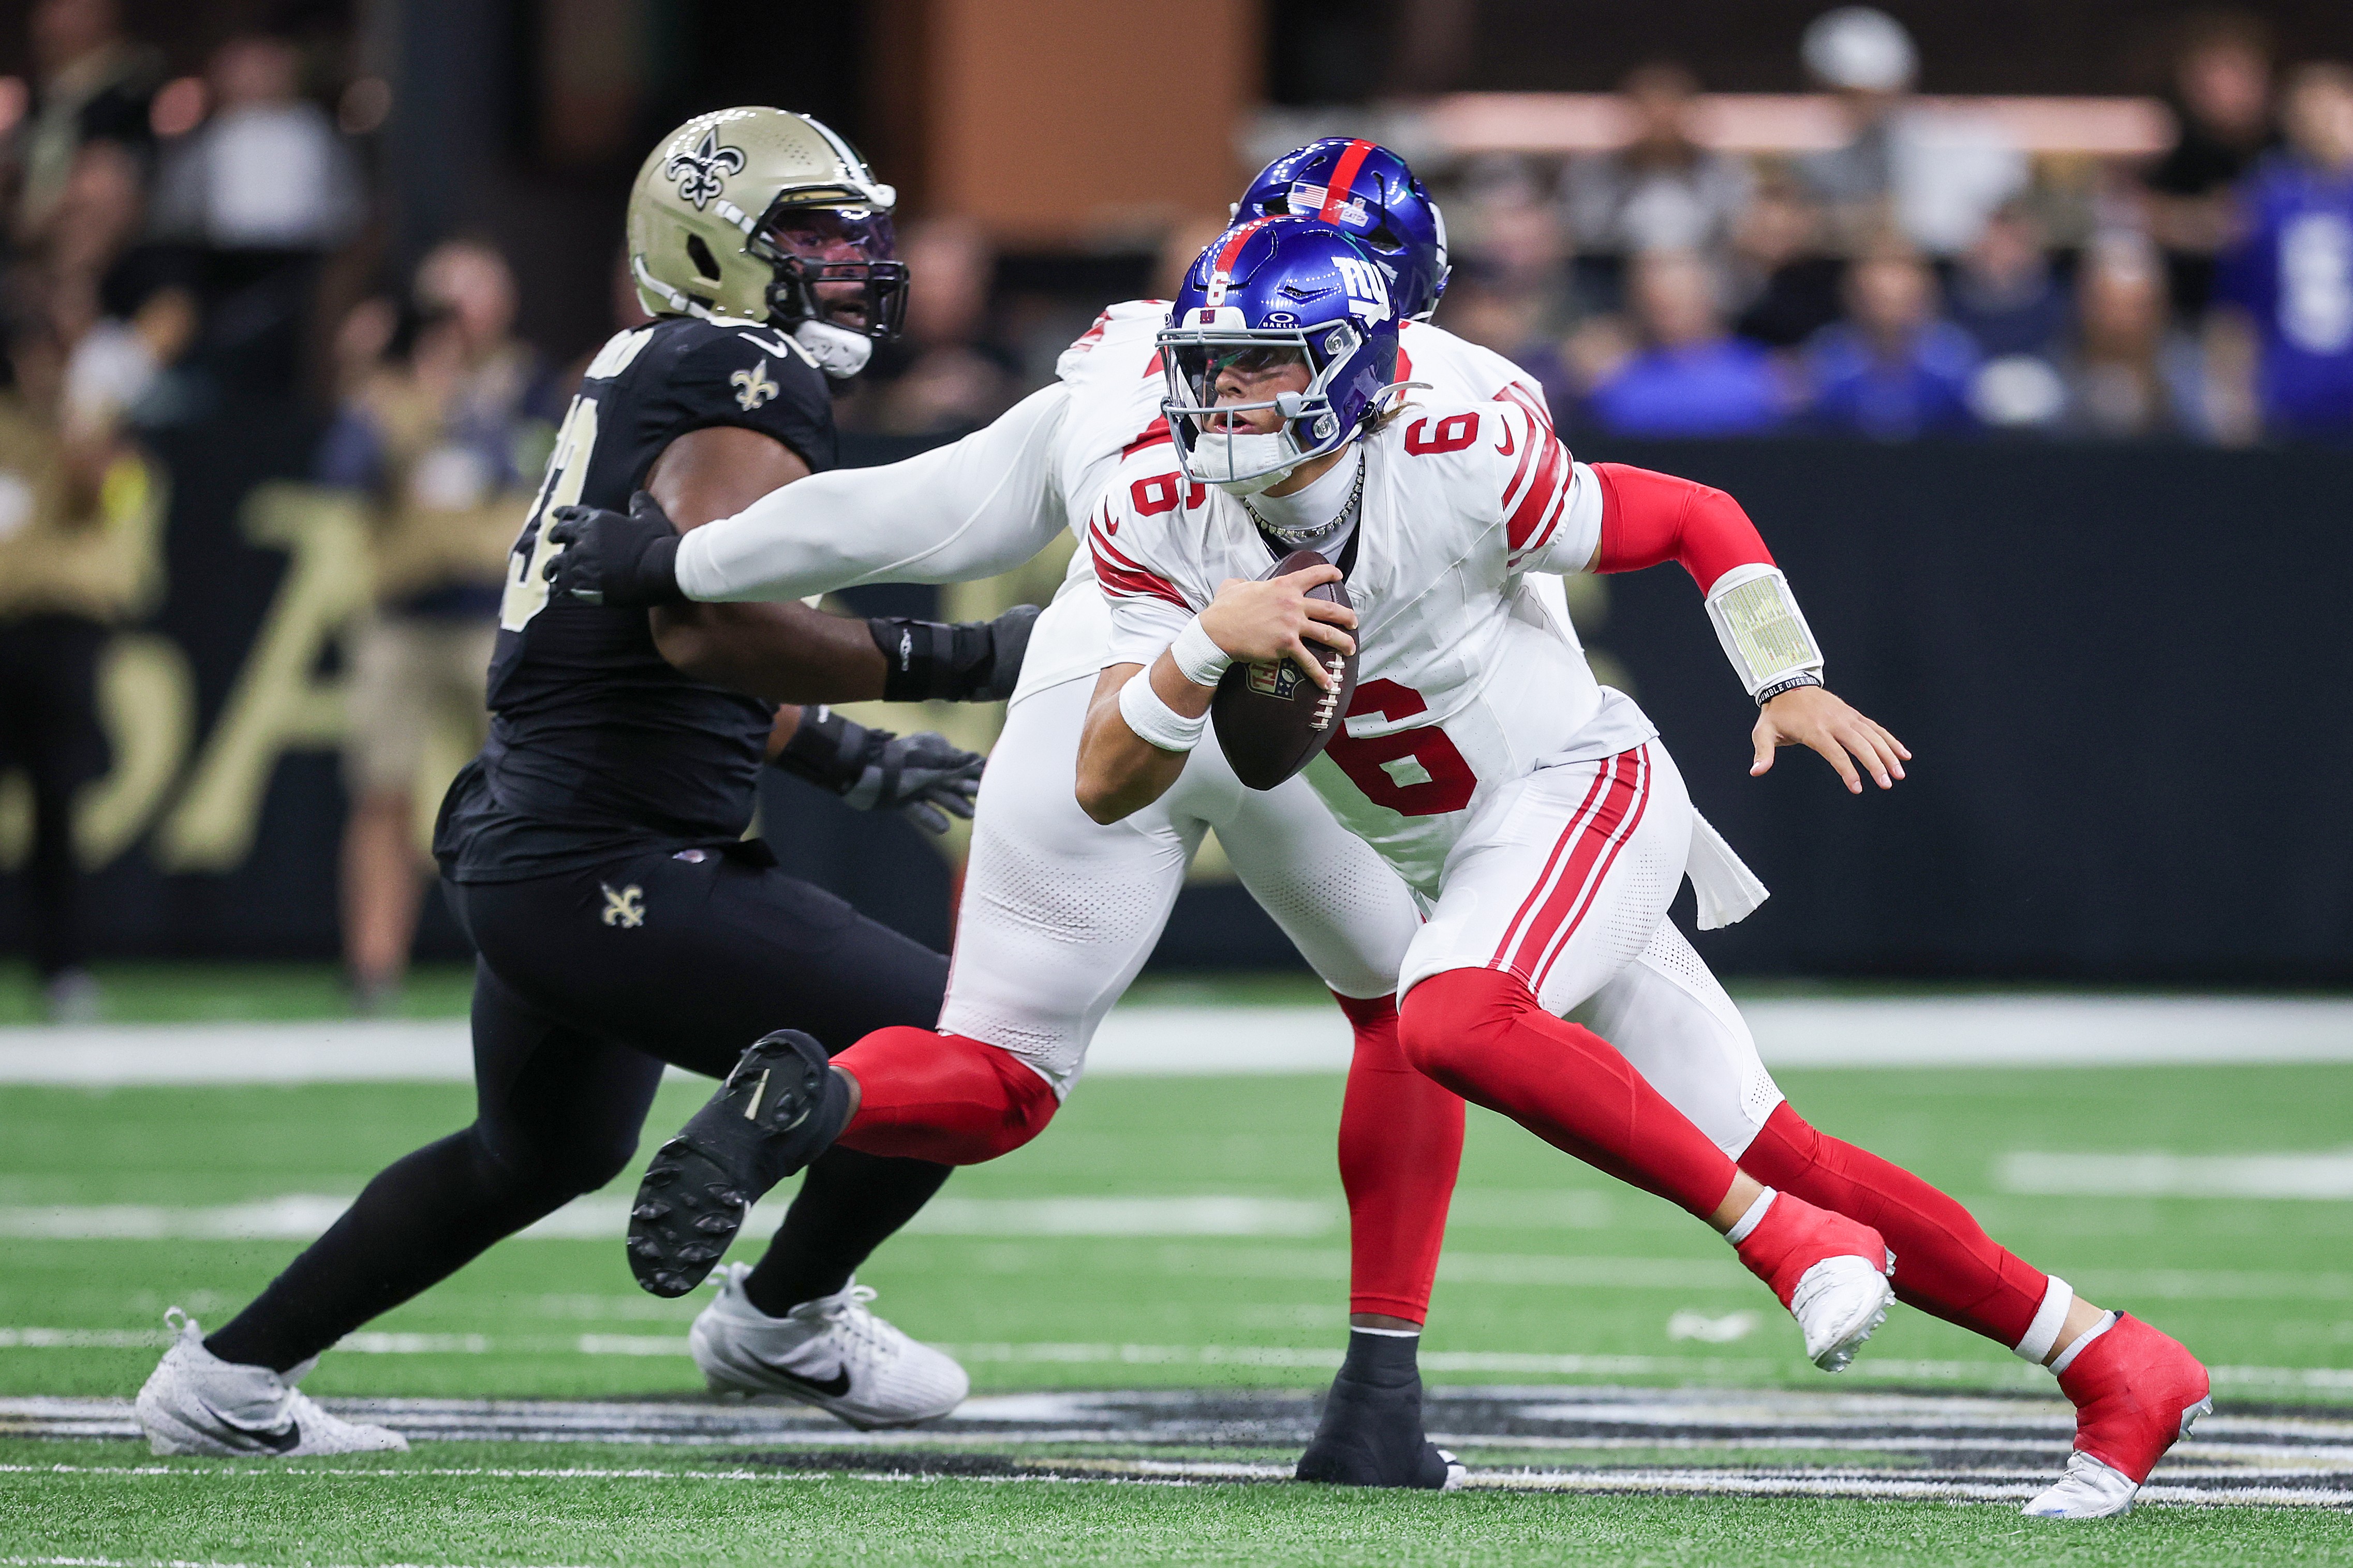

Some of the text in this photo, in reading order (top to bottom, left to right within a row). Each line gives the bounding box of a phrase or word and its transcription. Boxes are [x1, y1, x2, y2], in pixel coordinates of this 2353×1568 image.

[1206, 271, 1229, 306] 6
[1404, 412, 1480, 456] 6
[1130, 469, 1206, 517] 6
[1250, 662, 1279, 688] FL
[1785, 678, 1806, 689] OVER
[1323, 678, 1478, 817] 6
